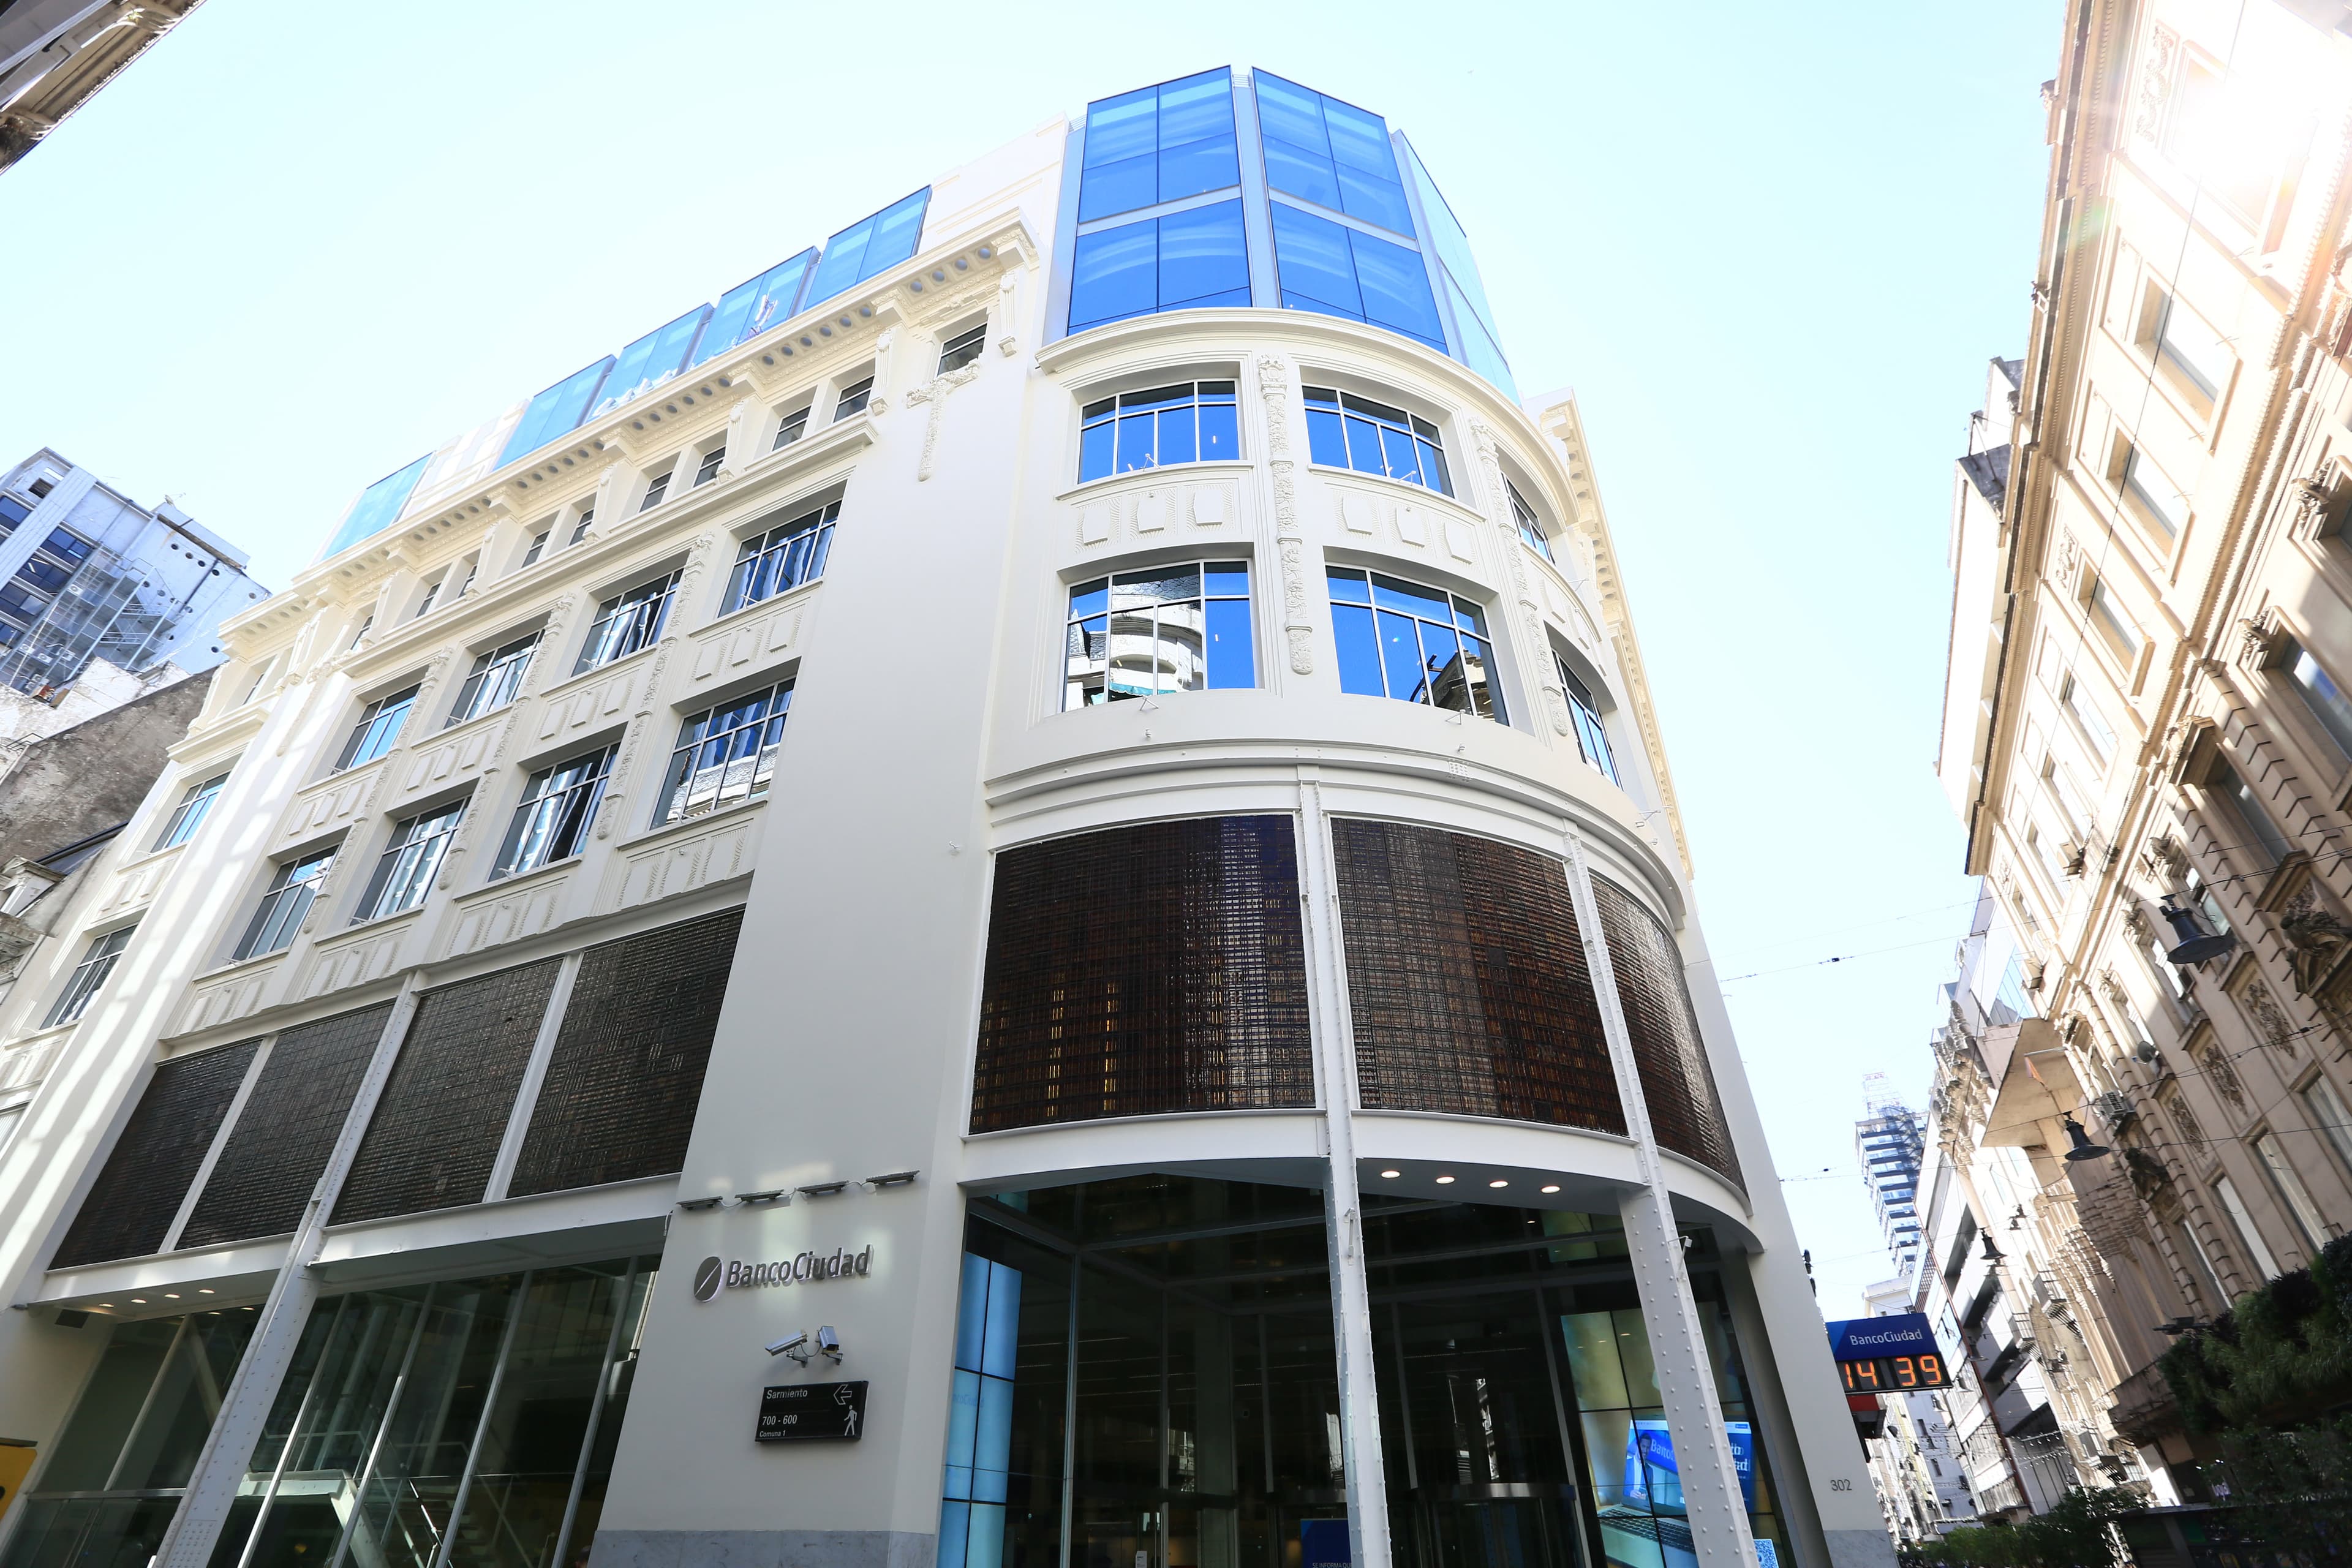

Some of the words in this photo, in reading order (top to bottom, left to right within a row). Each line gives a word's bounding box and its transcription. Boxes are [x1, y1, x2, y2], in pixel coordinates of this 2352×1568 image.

[726, 1244, 873, 1287] BancoCiudad
[1849, 1329, 1923, 1346] BancoCiudad
[1845, 1362, 1879, 1389] 14
[1896, 1355, 1942, 1387] 39
[766, 1389, 808, 1399] Sarmiento
[762, 1415, 776, 1425] 700
[783, 1415, 797, 1425] 600
[1830, 1479, 1853, 1491] 302
